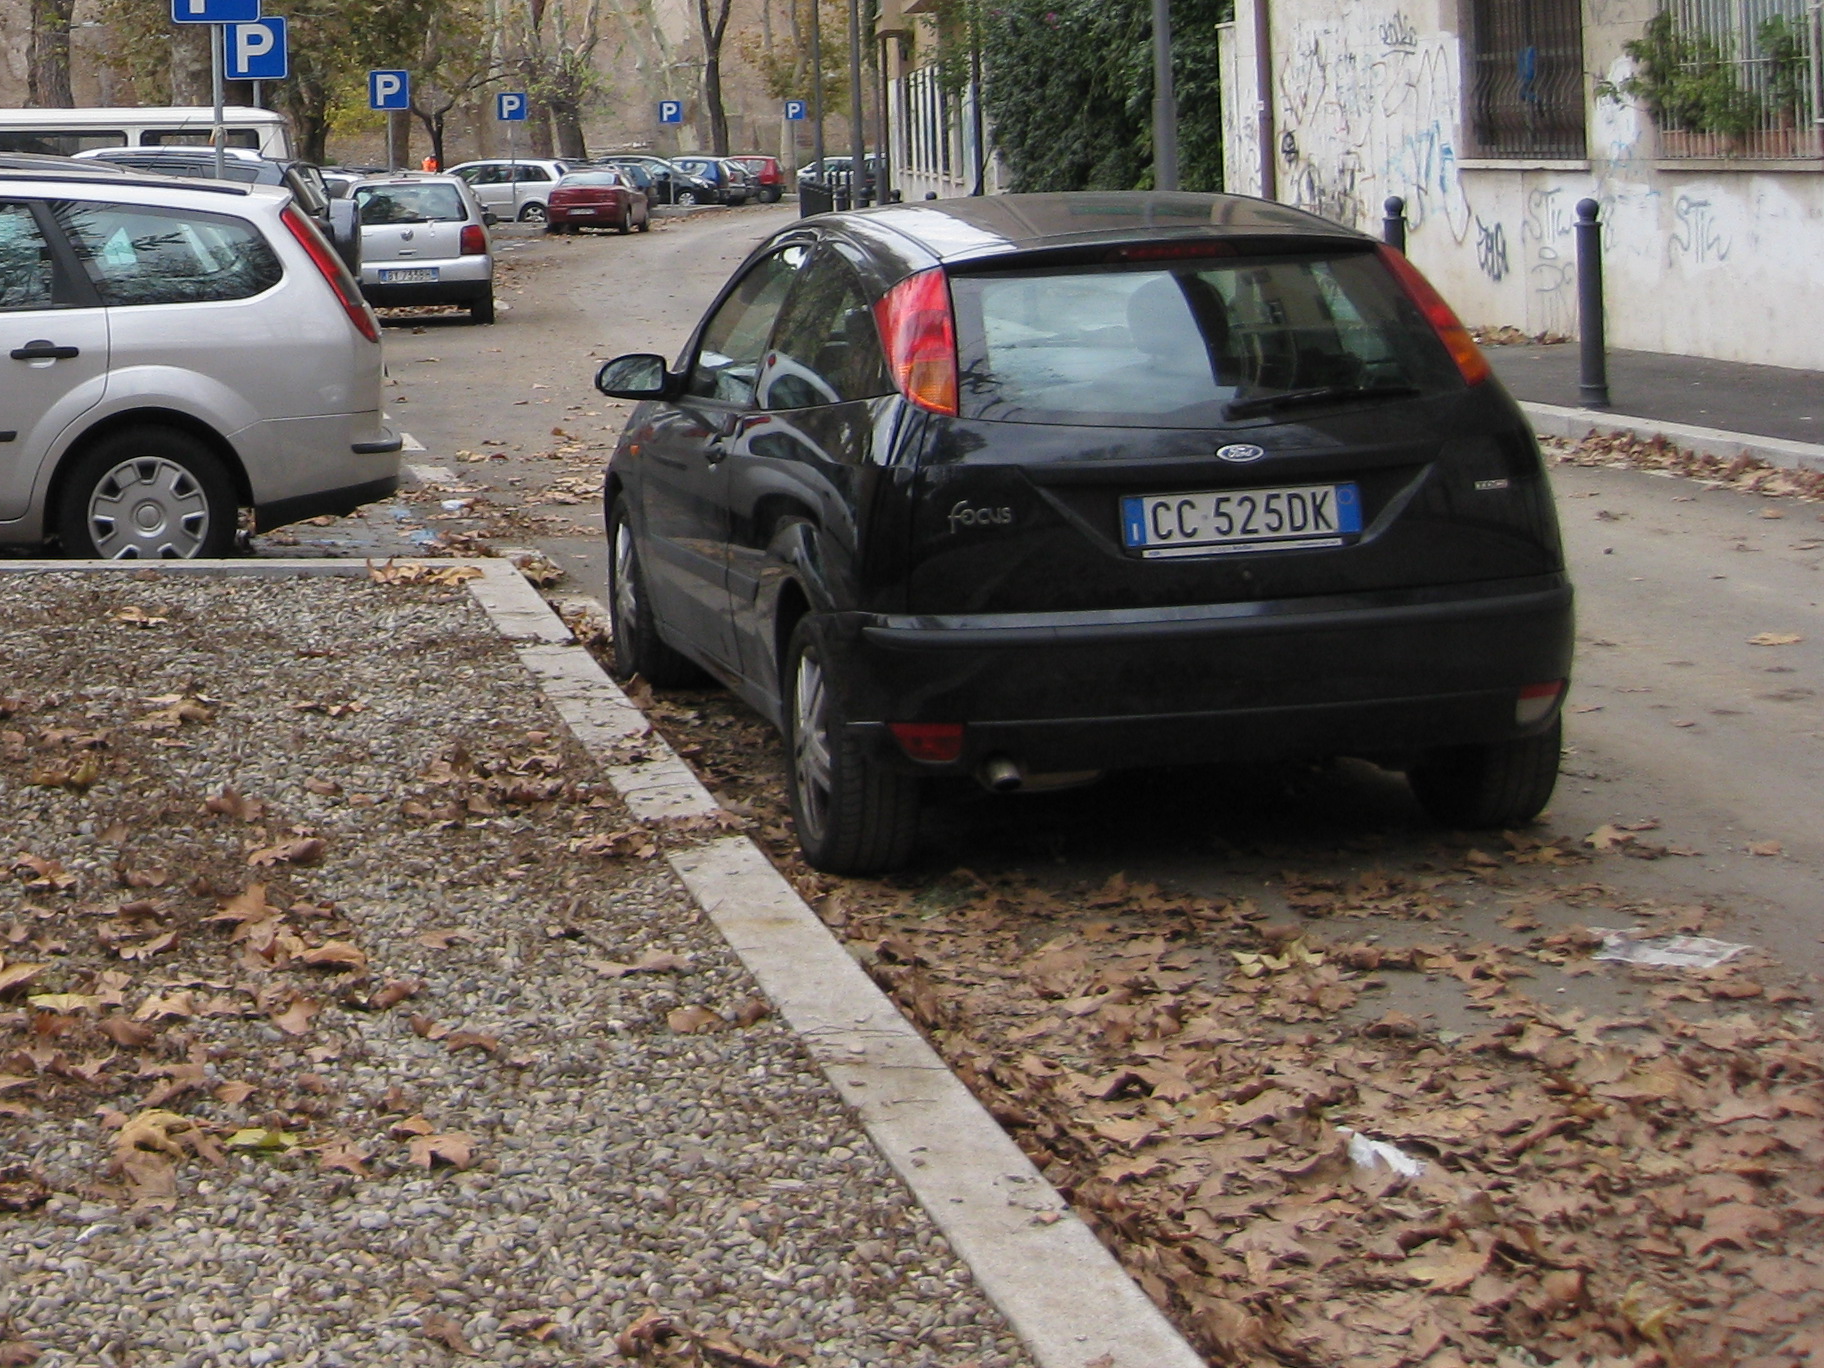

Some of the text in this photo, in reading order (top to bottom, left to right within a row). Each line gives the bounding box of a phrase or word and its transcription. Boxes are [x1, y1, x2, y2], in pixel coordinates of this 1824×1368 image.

[235, 23, 275, 73] P
[376, 73, 401, 106] P
[501, 95, 521, 119] P
[662, 102, 677, 122] P
[787, 102, 801, 119] P
[1151, 499, 1199, 540] CC
[1212, 490, 1333, 536] 525DK
